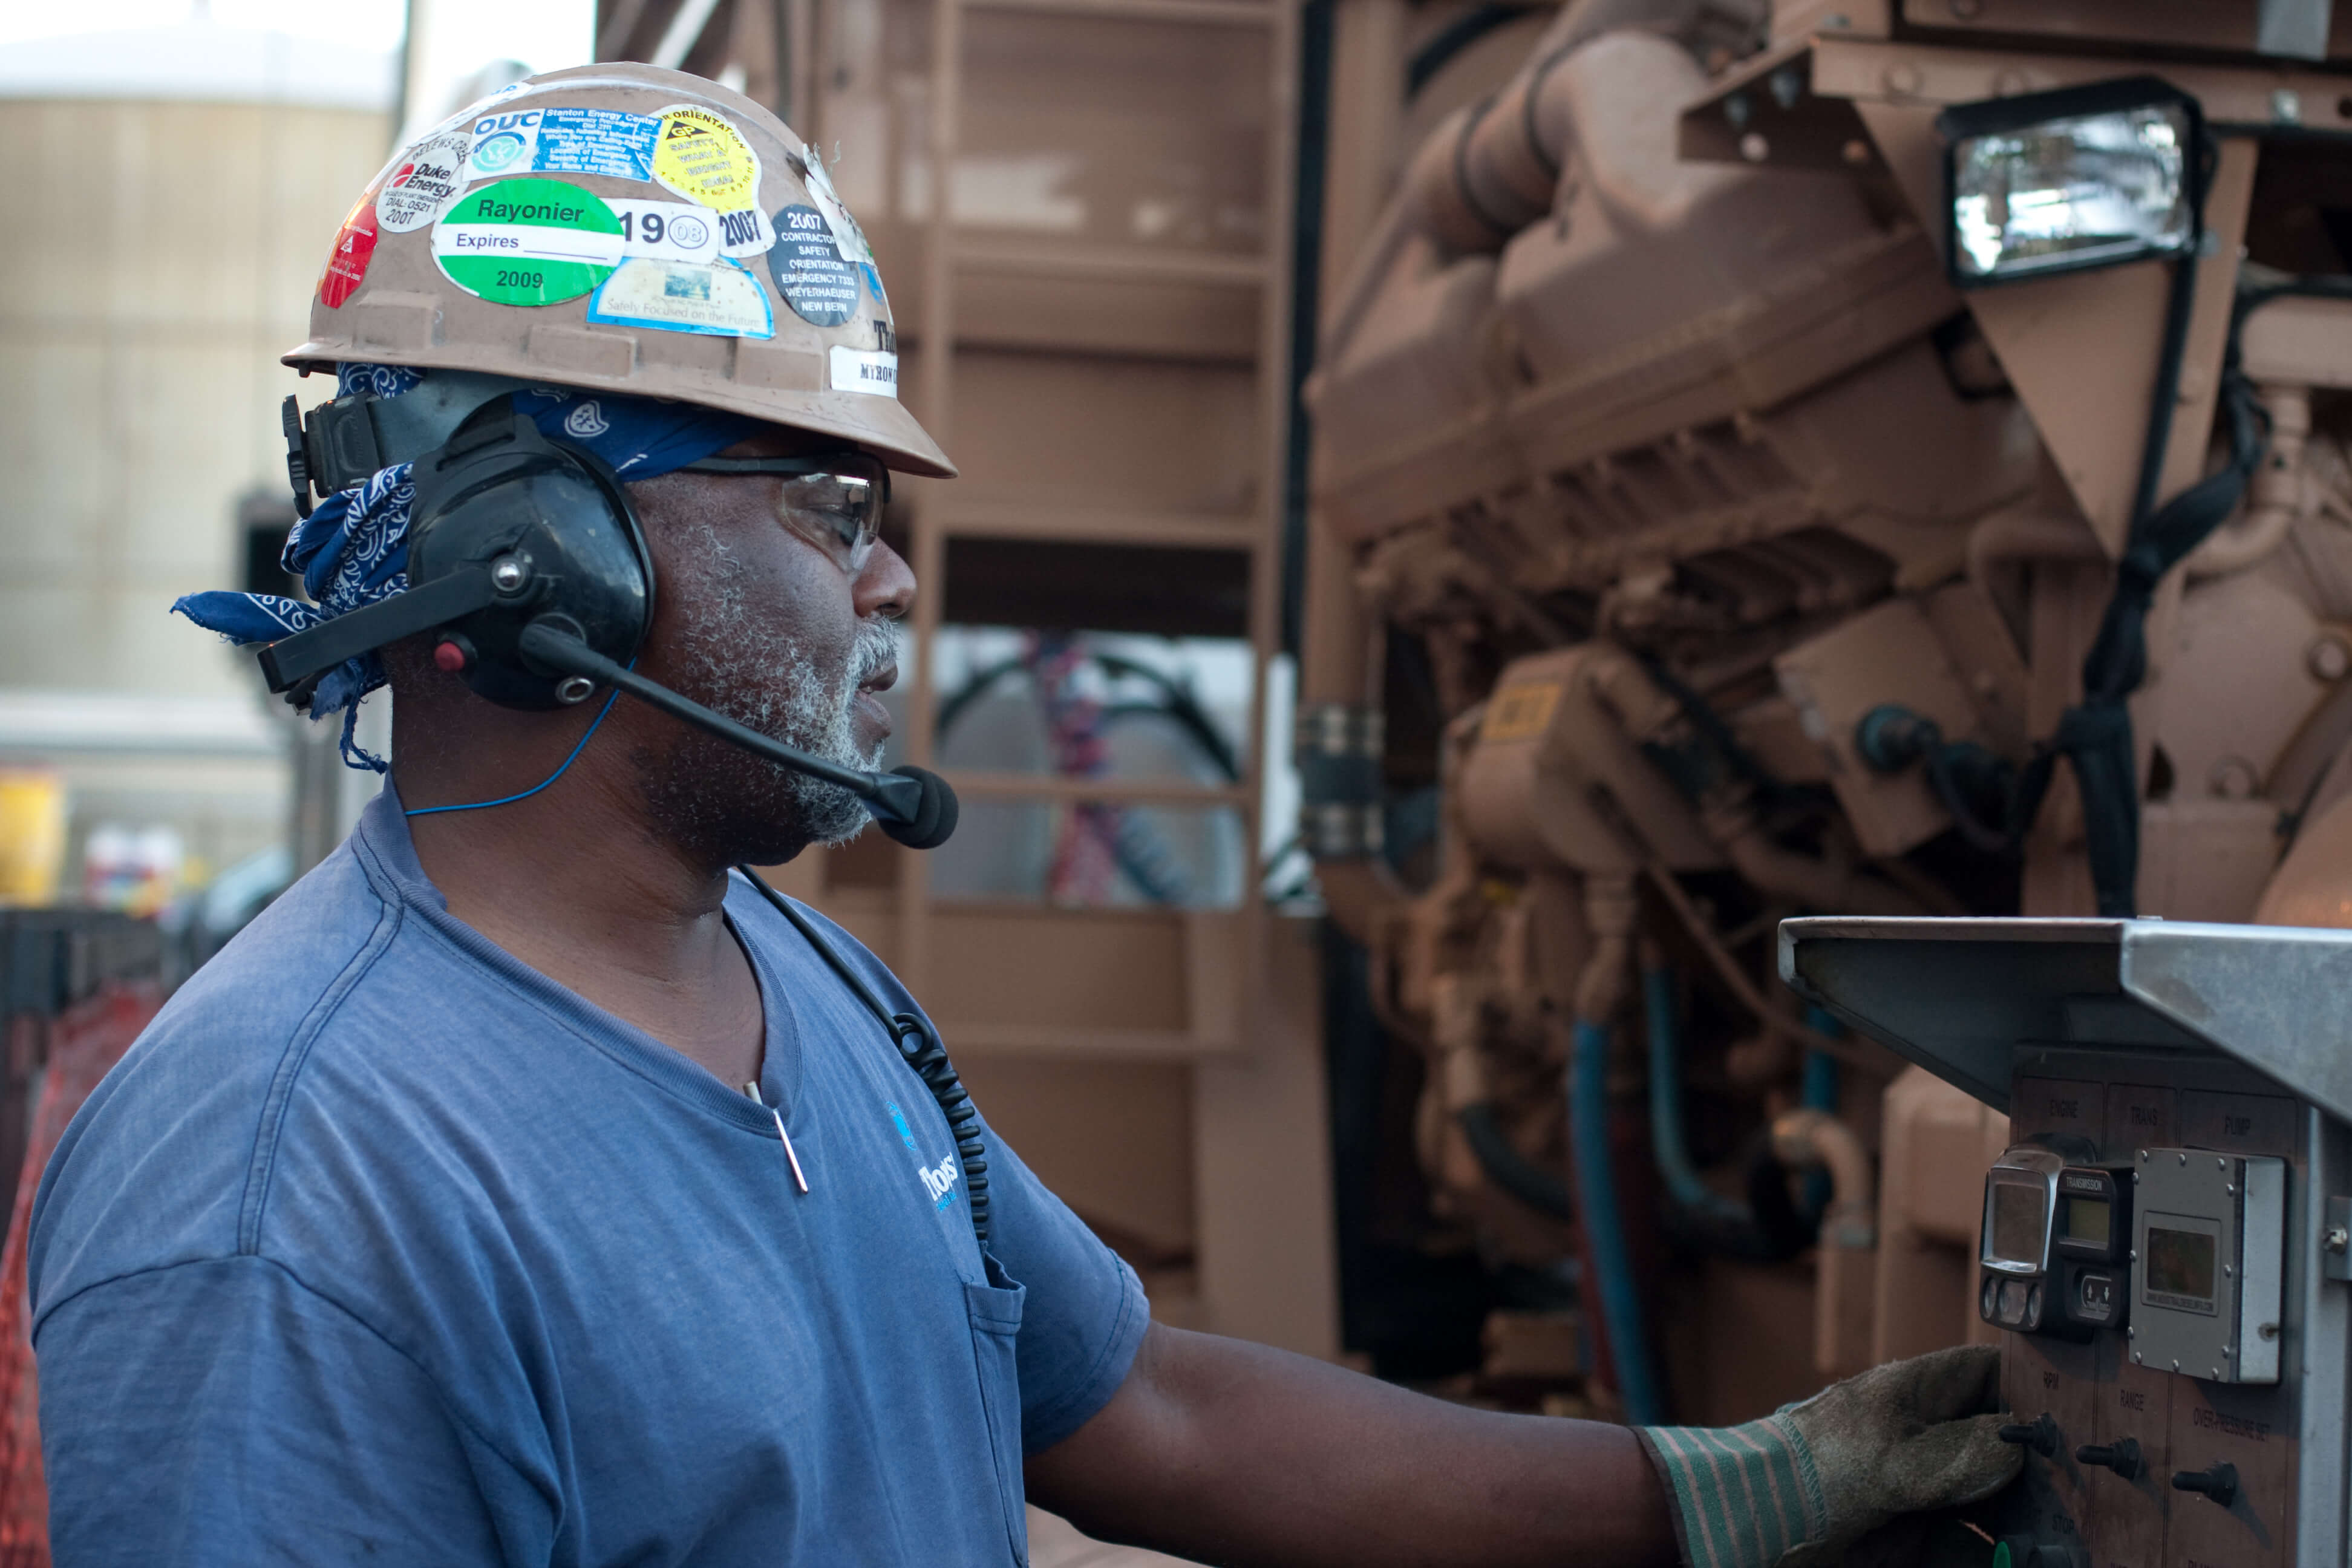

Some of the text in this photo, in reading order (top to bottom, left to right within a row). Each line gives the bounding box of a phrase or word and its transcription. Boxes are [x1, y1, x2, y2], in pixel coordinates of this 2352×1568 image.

[475, 112, 540, 135] OUC
[546, 109, 659, 126] Stanton Energy Center
[671, 125, 696, 136] GP
[673, 109, 746, 149] ORIENTATION
[415, 163, 451, 180] Duke
[405, 175, 456, 198] Energy
[408, 201, 431, 212] 0521
[478, 200, 585, 223] Rayonier
[386, 209, 415, 224] 2007
[788, 212, 820, 230] 2007
[674, 223, 702, 243] 08
[719, 210, 762, 247] 2007
[457, 234, 519, 250] Expires
[799, 246, 831, 256] SAFETY
[789, 260, 844, 272] ORIENTATION
[496, 271, 543, 289] 2009
[782, 273, 836, 284] EMERGENCY
[786, 287, 856, 300] WEYERHAEUSER
[643, 304, 688, 317] Focused
[691, 310, 705, 319] on
[708, 310, 726, 322] the
[802, 302, 847, 312] NEW BERN
[2130, 1105, 2158, 1126] TRANS
[2066, 1176, 2102, 1191] TRANSMISSION
[2043, 1371, 2059, 1390] RPM
[2120, 1389, 2145, 1412] RANGE
[2051, 1512, 2075, 1535] STOP
